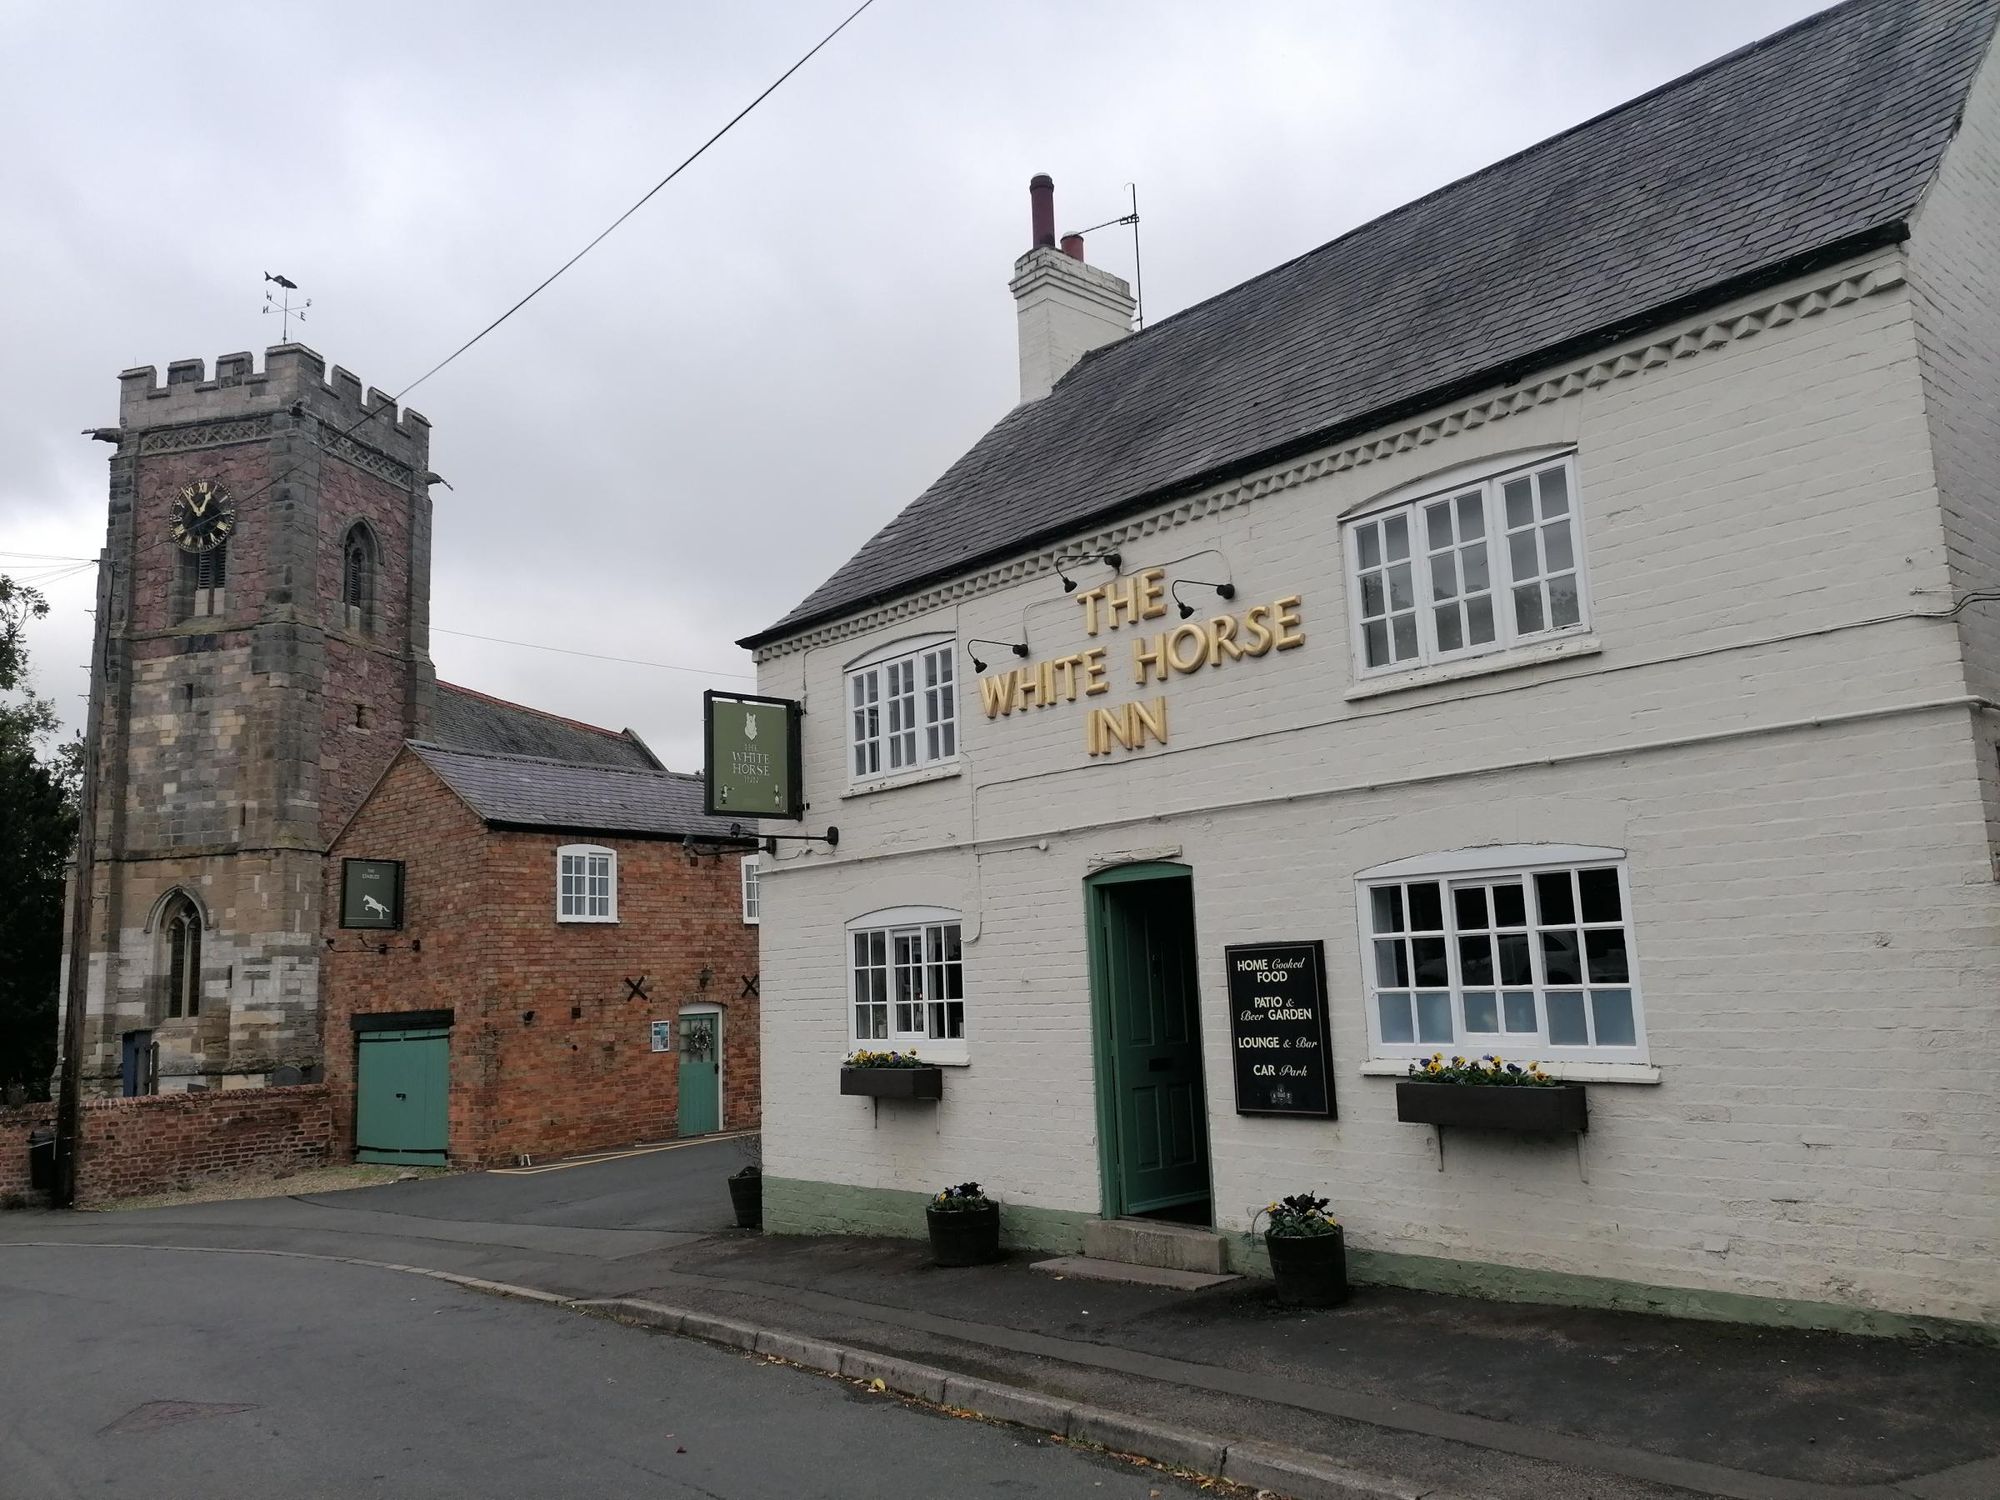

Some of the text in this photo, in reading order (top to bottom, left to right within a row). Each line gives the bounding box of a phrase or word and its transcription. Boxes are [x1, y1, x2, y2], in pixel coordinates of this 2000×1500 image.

[1077, 568, 1168, 637] THE
[979, 594, 1306, 719] WHITE HORSE
[1086, 694, 1168, 757] INN
[732, 751, 769, 764] WHITE
[732, 763, 769, 776] HORSE
[1237, 957, 1306, 971] HOME Cooked
[1257, 971, 1287, 982] FOOD
[1254, 996, 1295, 1008] PATIO &
[1240, 1008, 1312, 1022] Beer GARDEN
[1238, 1036, 1318, 1049] LOUNGE & Bar
[1253, 1064, 1308, 1077] CAR Park
